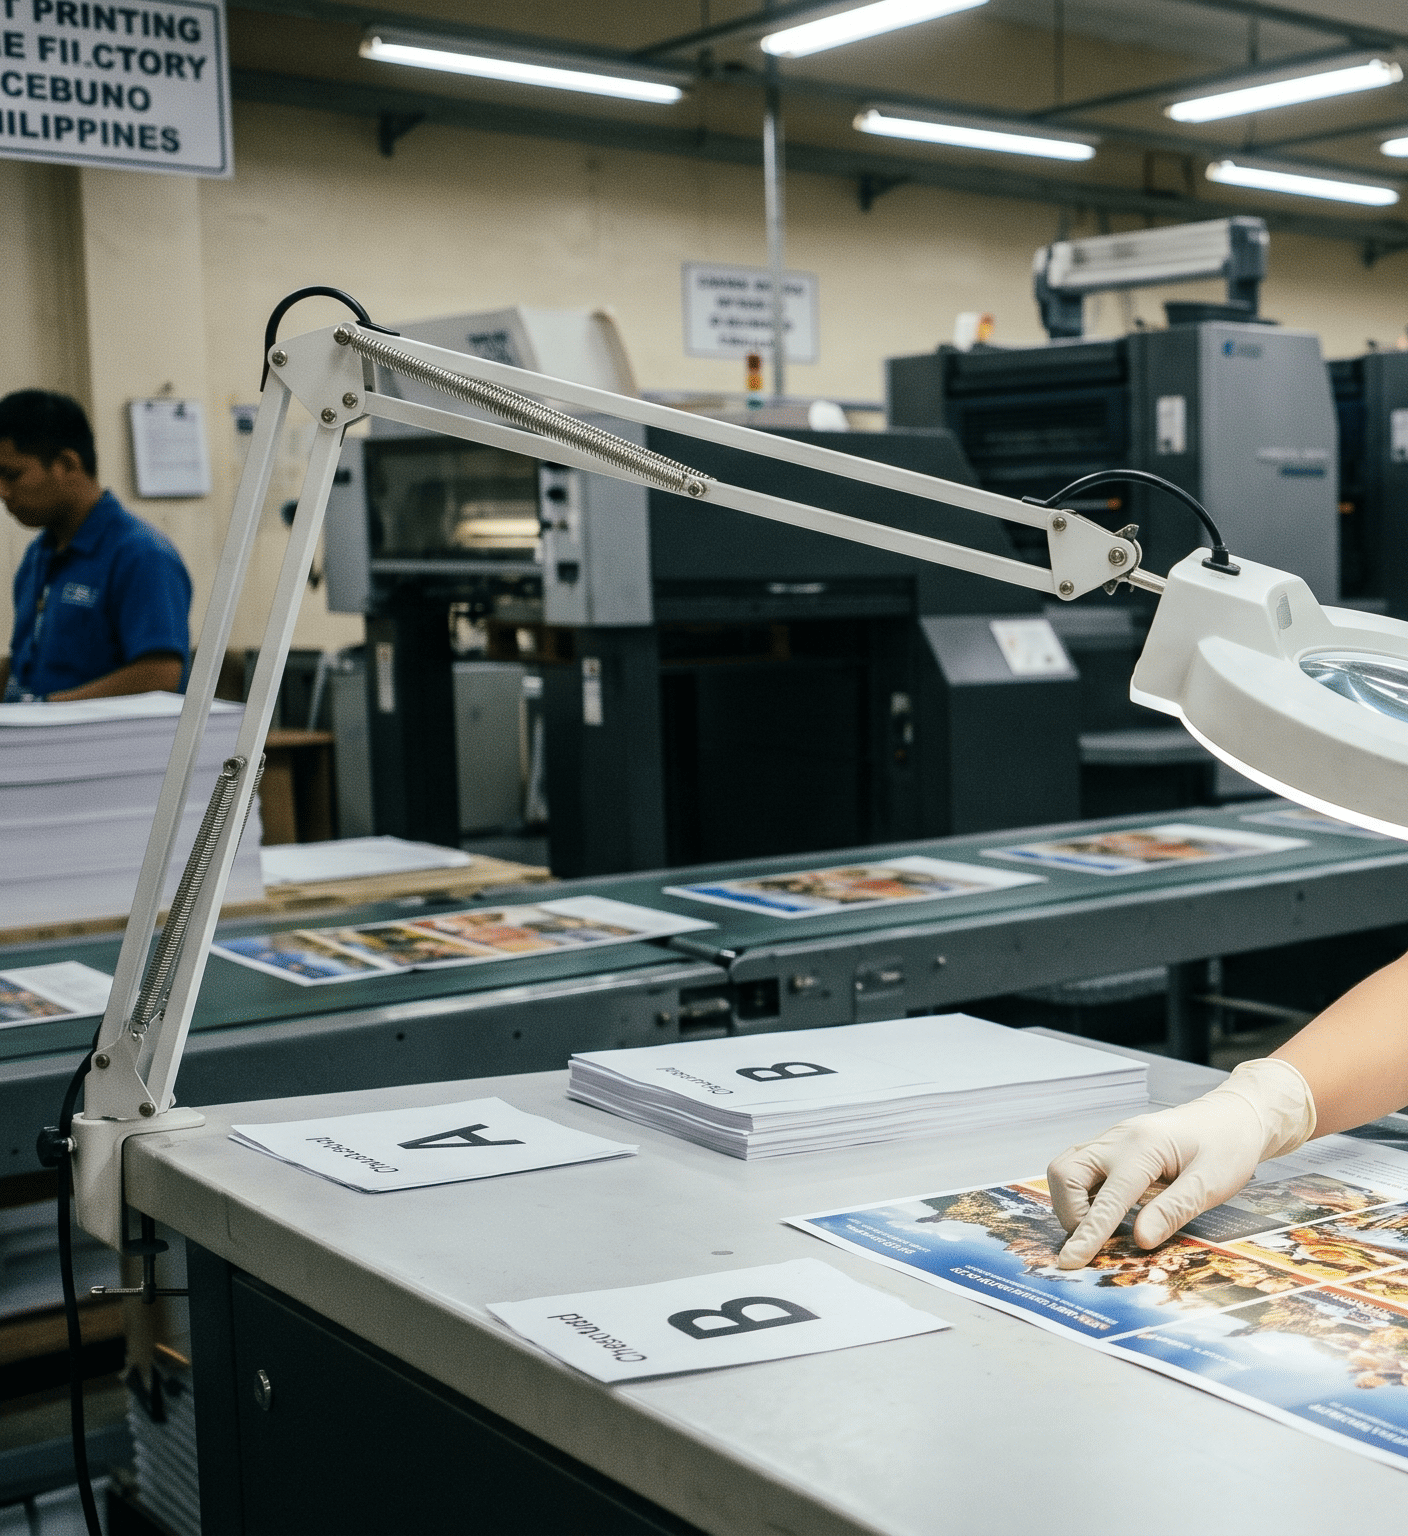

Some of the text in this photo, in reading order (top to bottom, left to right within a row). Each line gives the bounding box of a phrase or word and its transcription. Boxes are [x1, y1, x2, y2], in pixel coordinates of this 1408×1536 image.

[33, 0, 201, 43] PRINTING
[1, 70, 151, 112] CEBUNO
[0, 108, 180, 154] ILIPPINES
[735, 1062, 839, 1082] B
[397, 1123, 527, 1149] A
[667, 1296, 822, 1340] B
